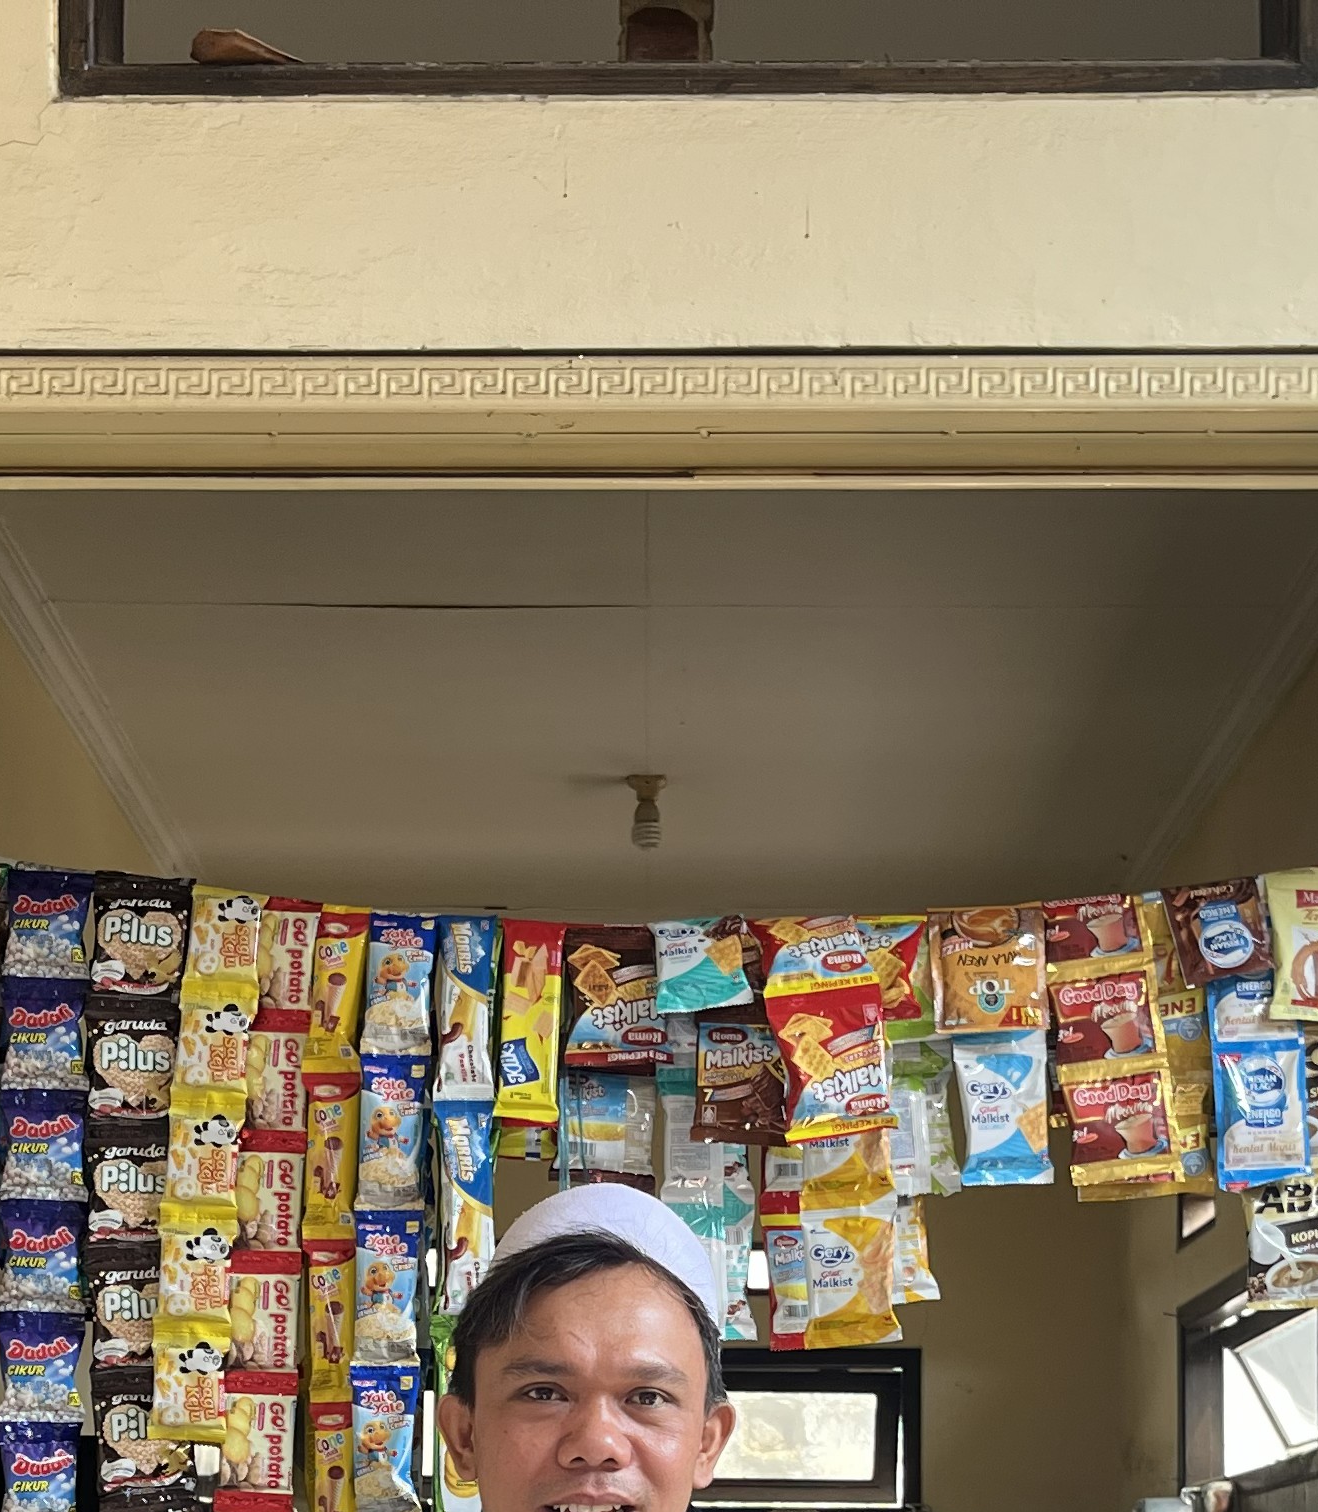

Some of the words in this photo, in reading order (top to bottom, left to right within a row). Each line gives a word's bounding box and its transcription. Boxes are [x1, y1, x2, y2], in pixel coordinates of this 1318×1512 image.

[13, 894, 79, 916] Dadali
[13, 919, 50, 930] CIKUR
[318, 941, 349, 961] Cone
[659, 946, 698, 958] Malkist
[789, 932, 862, 958] Malkist
[827, 953, 862, 965] Roma
[957, 952, 988, 966] AREN
[287, 949, 305, 1004] potato
[968, 978, 1015, 995] TOP
[1059, 984, 1103, 1005] Good
[1103, 981, 1137, 999] Day
[1236, 981, 1272, 991] ENERGO
[9, 1003, 75, 1029] Dadali
[104, 1019, 167, 1036] garuda
[712, 1030, 743, 1041] Roma
[10, 1033, 47, 1044] CIKUR
[628, 1031, 662, 1043] Roma
[705, 1044, 773, 1069] Malkist
[812, 1065, 886, 1101] Malkist
[704, 1089, 713, 1102] 7
[966, 1080, 1012, 1104] Gery
[1074, 1086, 1117, 1106] Good
[1117, 1083, 1151, 1101] Day
[850, 1097, 889, 1110] Roma
[314, 1104, 342, 1124] Cone
[971, 1113, 1011, 1124] Malkist
[1246, 1108, 1281, 1119] ENERGO
[10, 1114, 78, 1140] Dadali
[11, 1142, 49, 1154] CIKUR
[105, 1144, 166, 1159] garuda
[809, 1137, 850, 1149] Malkist
[1233, 1143, 1264, 1153] Kental
[274, 1191, 294, 1247] potato
[9, 1226, 76, 1253] Dadali
[1290, 1228, 1318, 1244] KOPI
[8, 1256, 47, 1269] CIKUR
[810, 1244, 855, 1268] Gery
[310, 1268, 340, 1290] Cone
[812, 1277, 853, 1289] Malkist
[104, 1287, 158, 1321] Pilu
[6, 1336, 73, 1361] Dadali
[269, 1313, 287, 1369] potato
[8, 1365, 45, 1376] CIKUR
[111, 1408, 147, 1442] Pil
[316, 1433, 344, 1453] Cone
[264, 1434, 284, 1489] potato
[13, 1481, 50, 1492] CIKUR
